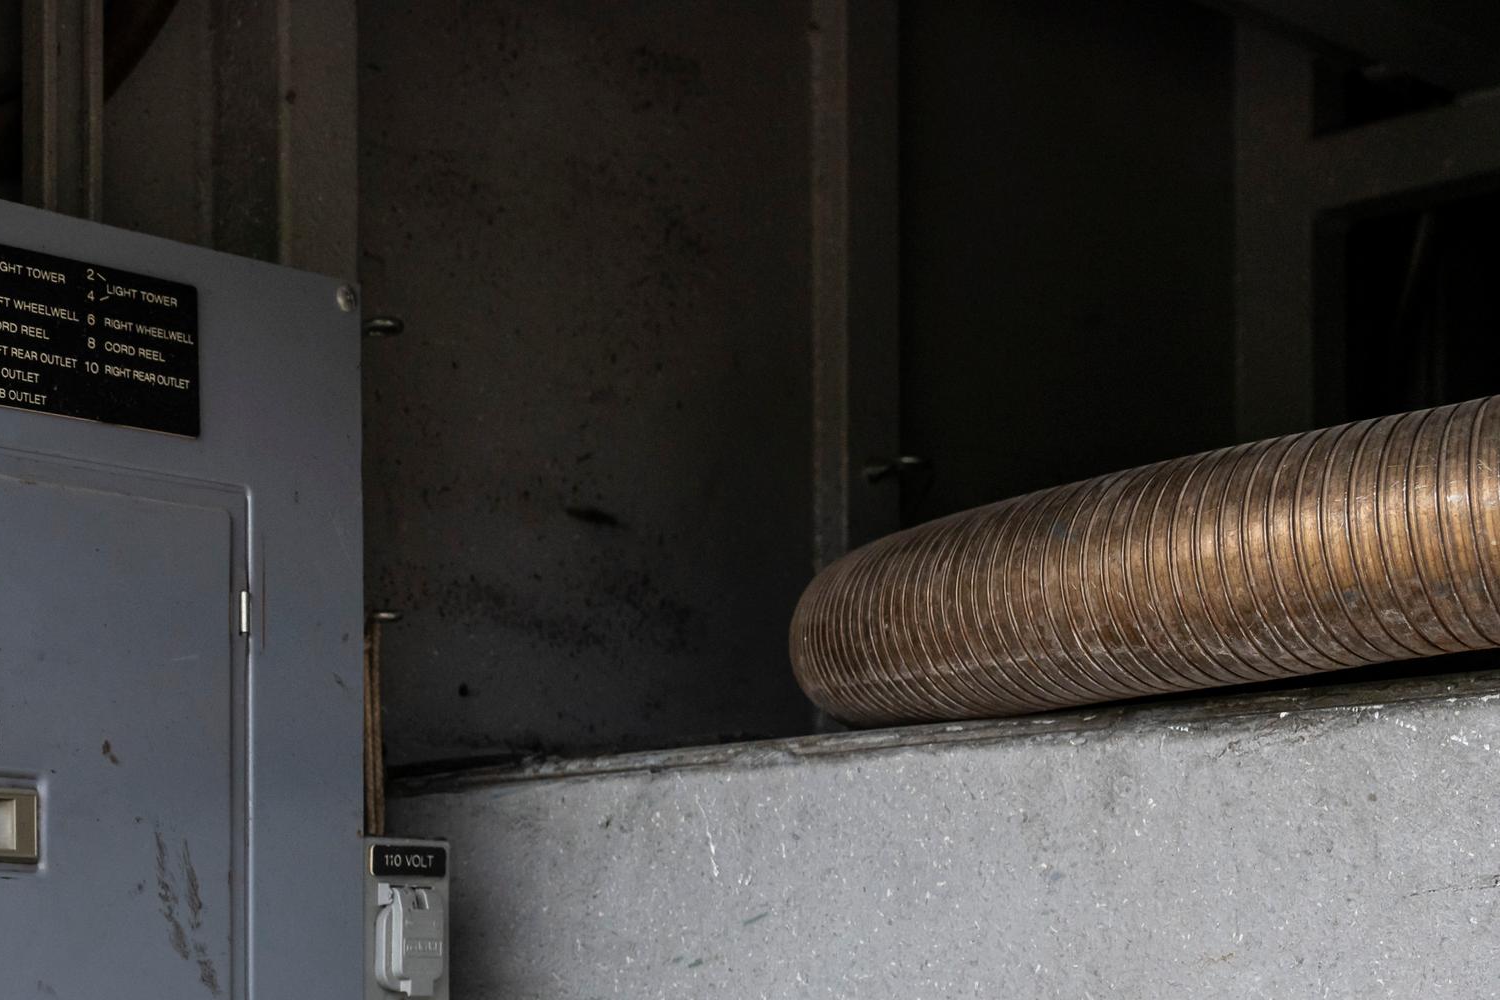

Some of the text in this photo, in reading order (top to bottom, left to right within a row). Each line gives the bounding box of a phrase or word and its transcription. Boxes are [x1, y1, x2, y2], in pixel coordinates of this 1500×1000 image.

[26, 266, 66, 284] TOWER
[86, 268, 95, 281] 2
[87, 290, 95, 301] 4
[106, 283, 178, 308] LIGHT TOWER
[13, 299, 80, 322] WHEELWELL
[87, 313, 95, 326] 6
[20, 325, 50, 340] REEL
[104, 317, 194, 345] RIGHT WHEELWELL
[87, 337, 96, 349] 8
[11, 347, 38, 361] REAR
[40, 352, 78, 368] OUTLET
[104, 341, 166, 363] CORD REEL
[1, 367, 40, 383] OUTLET
[85, 361, 99, 374] 10
[104, 364, 190, 389] RIGHT REAR OUTLET
[8, 390, 47, 405] OUTLET
[384, 854, 434, 868] 110 VOLT
